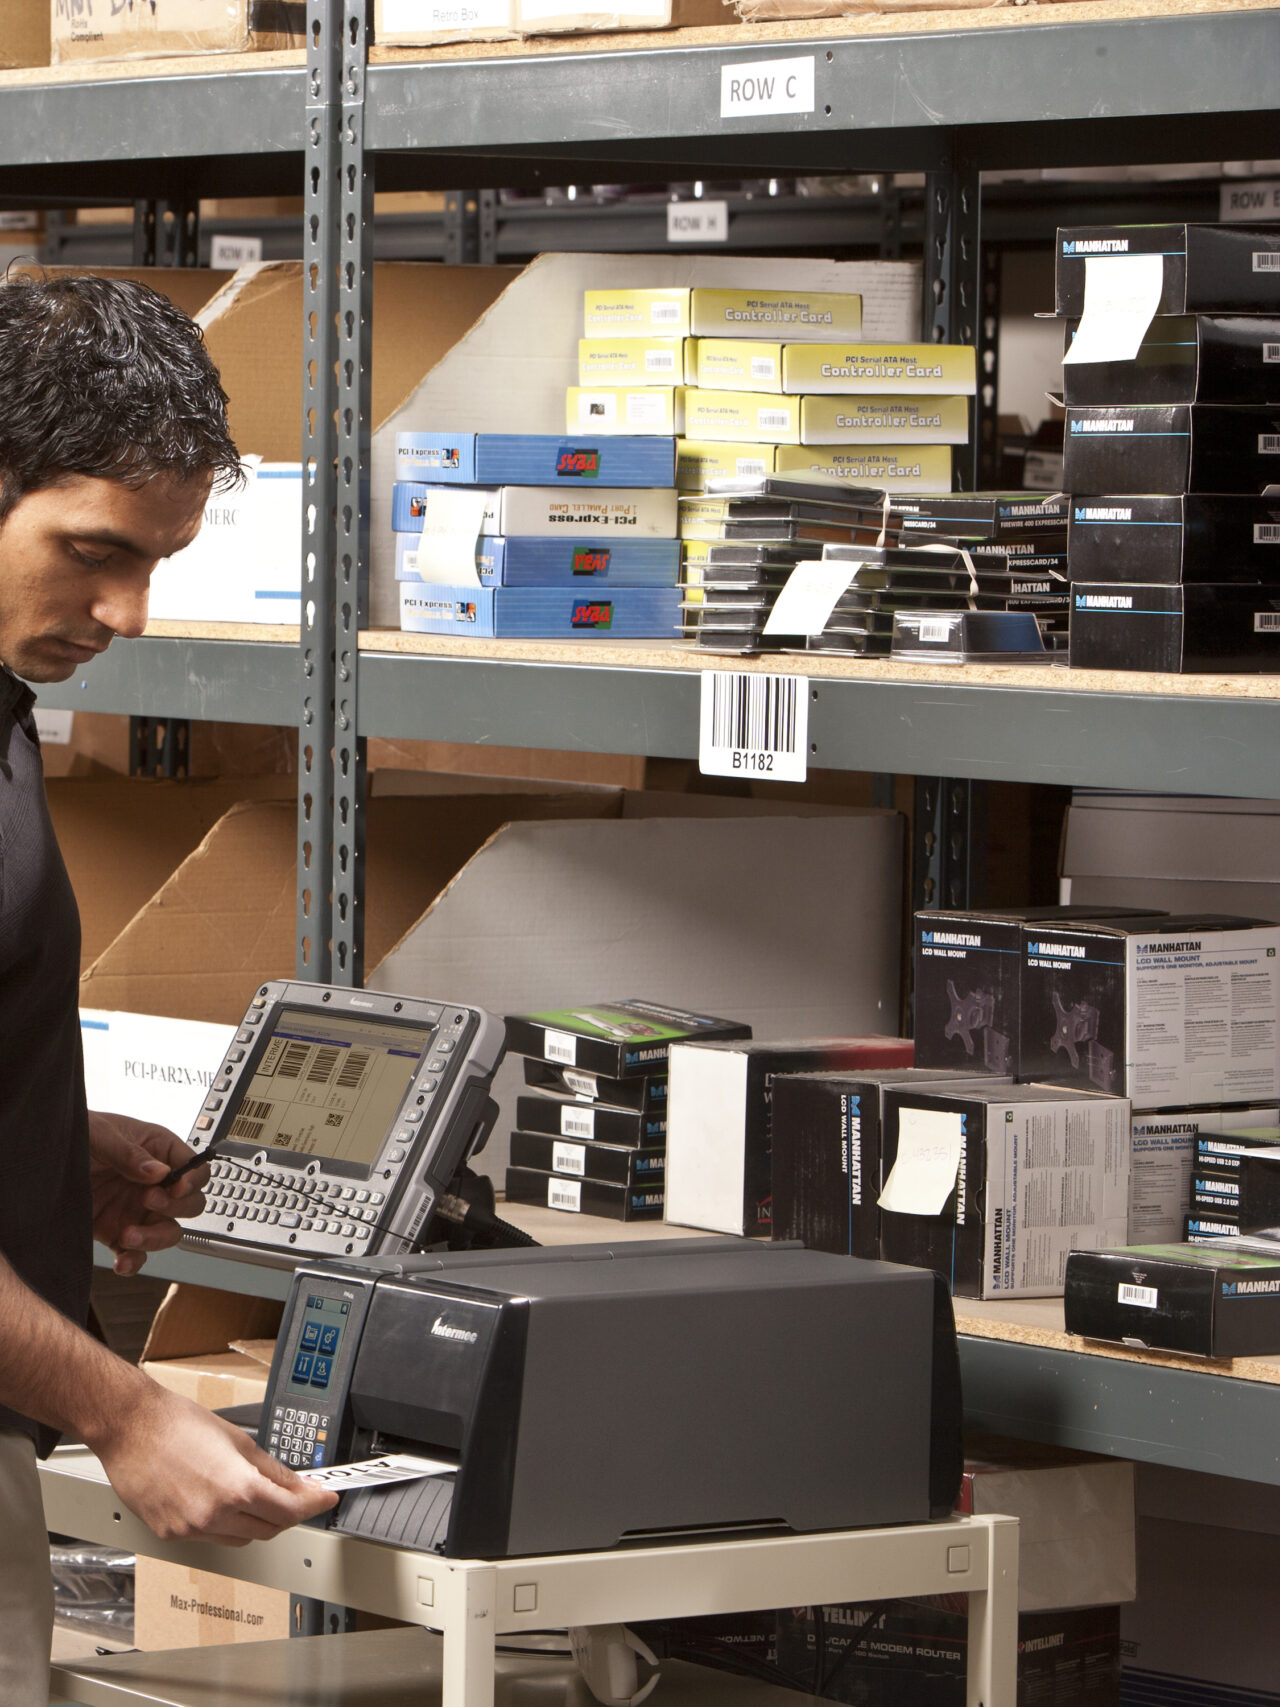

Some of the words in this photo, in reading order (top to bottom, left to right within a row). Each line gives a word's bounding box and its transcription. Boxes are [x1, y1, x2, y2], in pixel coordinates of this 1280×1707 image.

[432, 9, 459, 23] Retro
[461, 7, 480, 22] Box
[71, 32, 104, 42] Compliant
[730, 77, 775, 102] ROW
[786, 75, 797, 98] C
[1230, 191, 1267, 209] ROW
[672, 215, 701, 230] ROW
[1075, 240, 1129, 252] MANHATTAN
[746, 301, 758, 310] PCI
[759, 301, 778, 310] Serial
[779, 301, 794, 310] ATA
[794, 301, 810, 310] Host
[725, 309, 799, 322] Controller
[800, 310, 832, 323] Card
[845, 355, 859, 364] PCI
[860, 355, 882, 364] Serial
[883, 355, 898, 364] ATA
[900, 355, 917, 364] Host
[821, 365, 903, 378] Controller
[906, 365, 943, 378] Card
[857, 406, 869, 414] PCI
[870, 406, 889, 414] Serial
[890, 406, 903, 414] ATA
[904, 406, 919, 414] Host
[836, 414, 907, 427] Controller
[909, 414, 941, 427] Card
[1082, 420, 1134, 432] MANHATTAN
[398, 448, 409, 456] PCI
[411, 448, 440, 457] Express
[833, 456, 845, 464] PCI
[846, 456, 867, 464] Serial
[867, 456, 881, 464] ATA
[882, 456, 898, 464] Host
[1011, 504, 1060, 516] MANHATTAN
[1086, 508, 1132, 520] MANHATTAN
[548, 514, 637, 525] PCI-Express
[977, 544, 1035, 555] MANHATTAN
[1009, 558, 1058, 566] XPRESSCARD/34
[419, 600, 453, 608] Express
[1086, 595, 1133, 608] MANHATTAN
[732, 751, 773, 771] B1182
[933, 932, 981, 947] MANHATTAN
[922, 947, 933, 956] LCD
[933, 948, 947, 957] WALL
[947, 949, 967, 959] MOUNT
[1038, 942, 1086, 958] MANHATTAN
[1149, 941, 1201, 954] MANHATTAN
[1027, 958, 1038, 967] LCD
[1038, 959, 1052, 968] WALL
[1052, 960, 1072, 970] MOUNT
[1136, 957, 1151, 965] LCD
[1153, 956, 1172, 964] WALL
[1174, 955, 1200, 963] MOUNT
[1146, 1123, 1199, 1135] MANHATTAN
[852, 1117, 861, 1205] MANHATTAN
[1205, 1180, 1239, 1194] MANHATTA
[993, 1208, 1003, 1273] MANHATTAN
[431, 1316, 478, 1343] Intermec
[170, 1595, 264, 1626] Max-Professional.com
[1025, 1633, 1064, 1653] INTELLINET
[870, 1641, 913, 1655] MODEM
[915, 1647, 961, 1660] ROUTER
